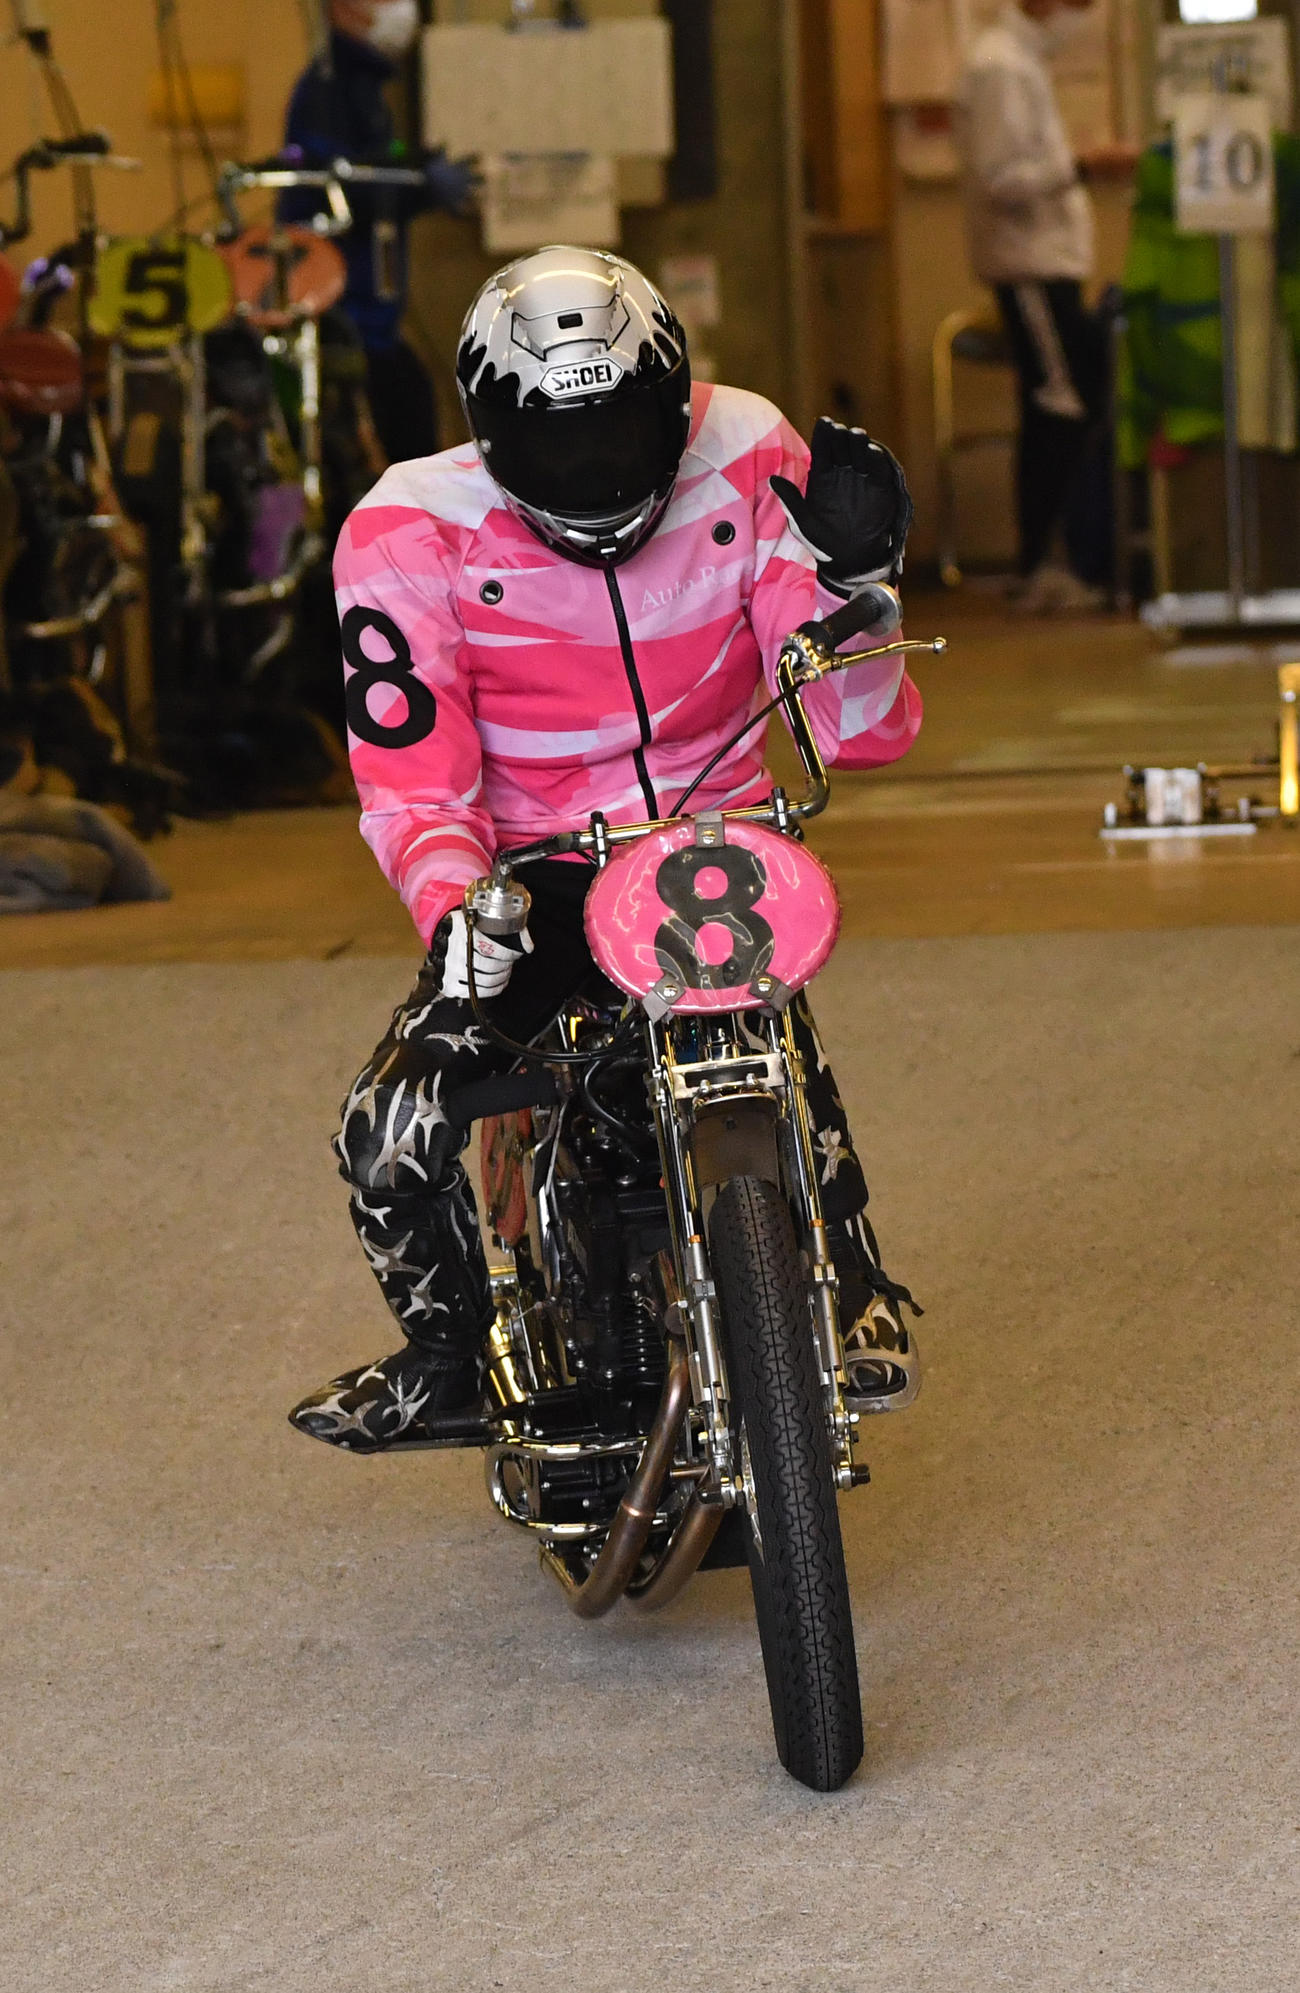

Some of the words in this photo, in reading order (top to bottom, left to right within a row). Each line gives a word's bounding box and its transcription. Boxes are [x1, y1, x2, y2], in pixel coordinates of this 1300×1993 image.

[1193, 131, 1264, 195] 10
[122, 251, 187, 328] 5
[551, 364, 612, 391] SHOEI
[641, 577, 694, 611] Auto
[341, 604, 437, 749] 8
[654, 844, 774, 989] 8
